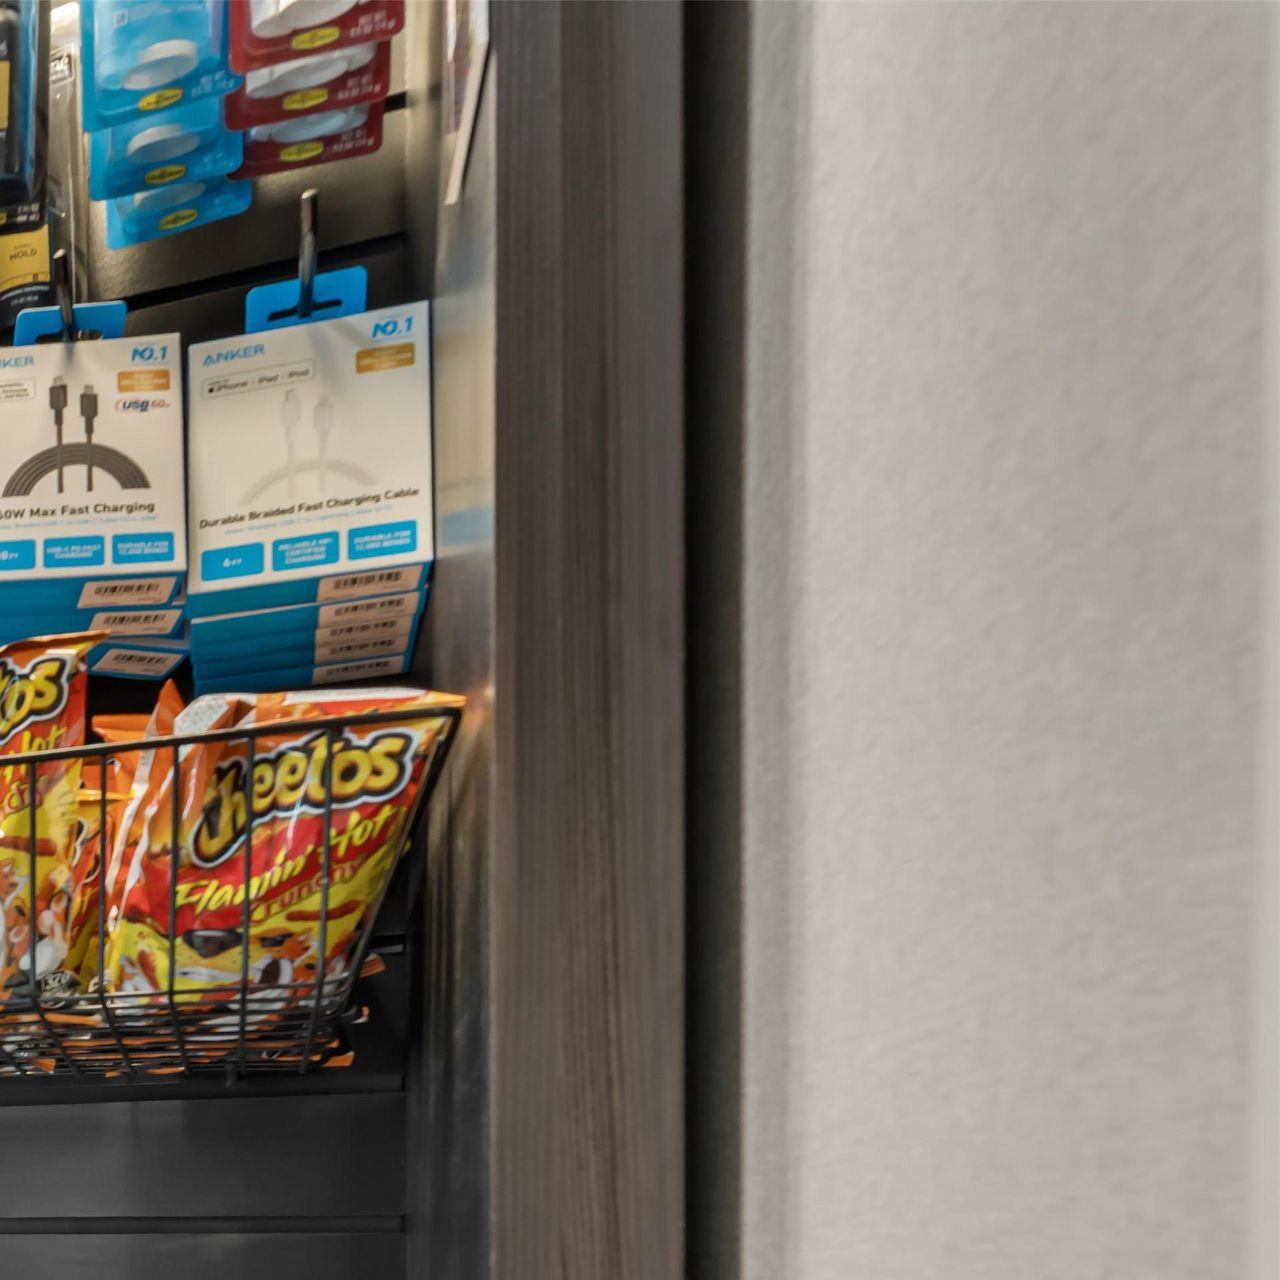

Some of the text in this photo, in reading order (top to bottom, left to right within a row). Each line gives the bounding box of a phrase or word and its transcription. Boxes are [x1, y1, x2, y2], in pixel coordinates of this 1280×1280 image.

[131, 345, 168, 362] NO.1
[202, 316, 414, 367] ANKER NO.1
[29, 506, 57, 517] Max
[61, 505, 89, 515] Fast
[93, 502, 155, 514] Charging
[200, 515, 245, 529] Durable
[248, 506, 294, 521] Braided
[298, 502, 324, 513] Fast
[326, 494, 381, 509] Charging
[384, 488, 419, 500] Cable
[193, 732, 413, 863] Cheetos
